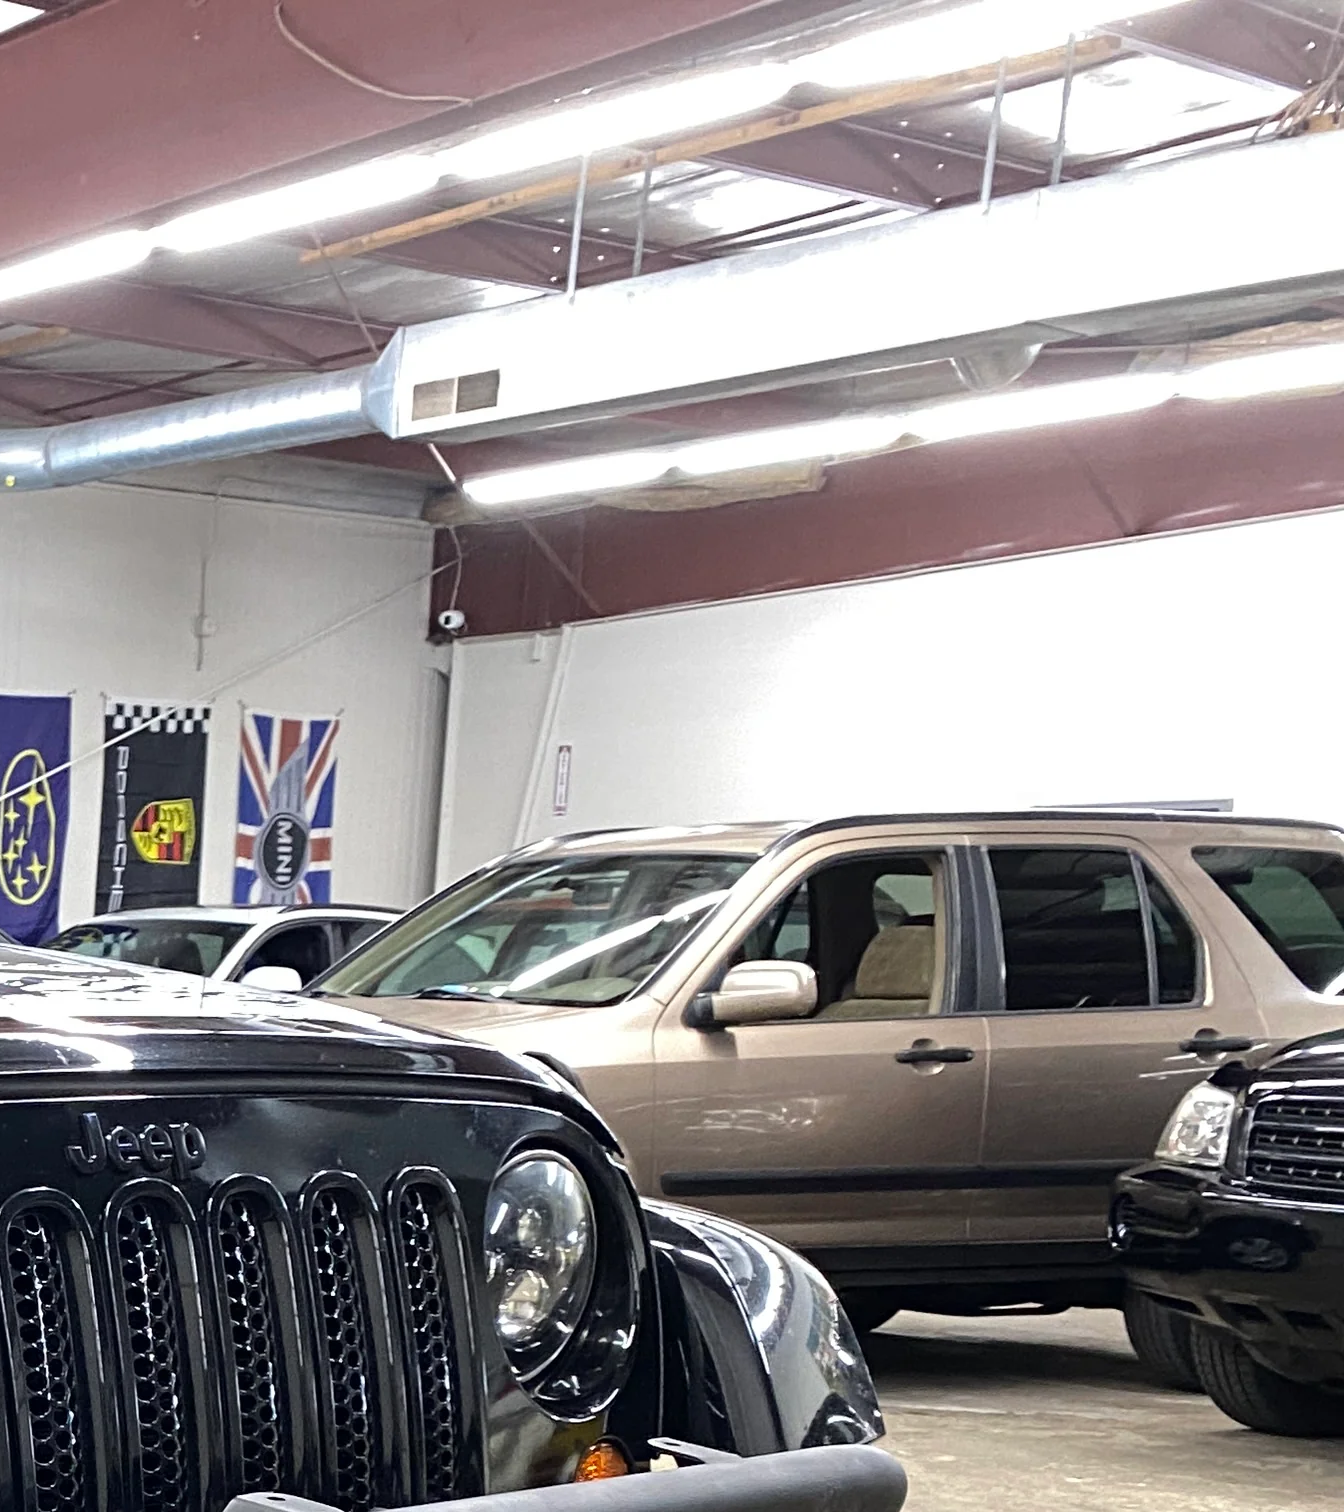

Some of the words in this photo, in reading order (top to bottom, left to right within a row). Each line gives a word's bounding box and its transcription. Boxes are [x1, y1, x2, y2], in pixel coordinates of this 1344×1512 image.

[108, 746, 130, 912] PORSCHE
[276, 820, 293, 883] MINI
[66, 1112, 207, 1180] Jeep
